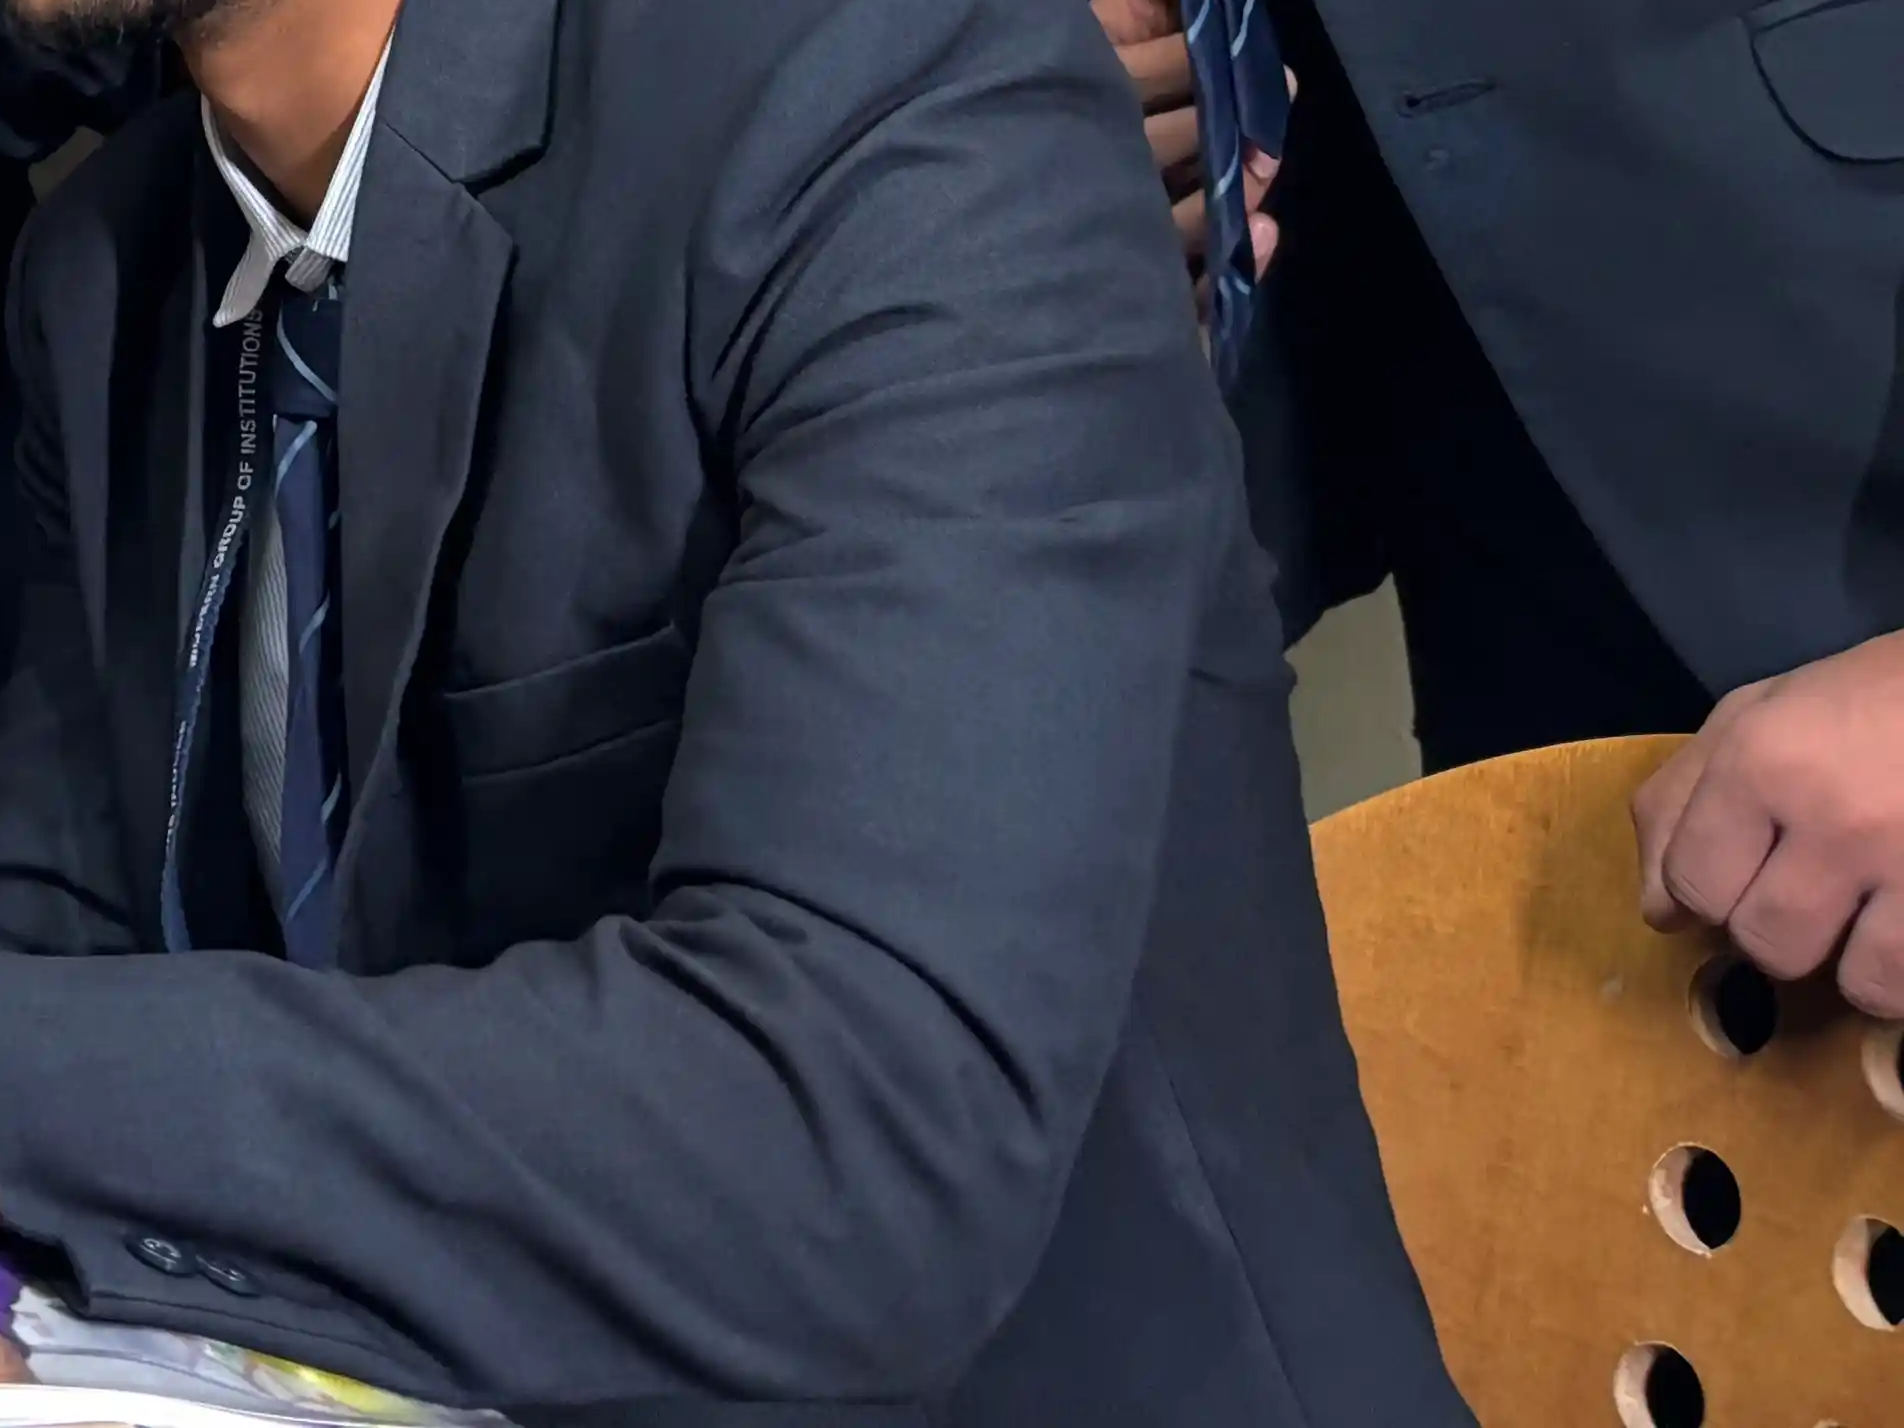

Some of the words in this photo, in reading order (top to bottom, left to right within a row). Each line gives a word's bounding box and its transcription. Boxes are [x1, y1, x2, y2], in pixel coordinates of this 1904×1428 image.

[238, 308, 264, 455] INSTITUTIONS
[237, 461, 254, 491] OF
[213, 496, 246, 569] GROUP
